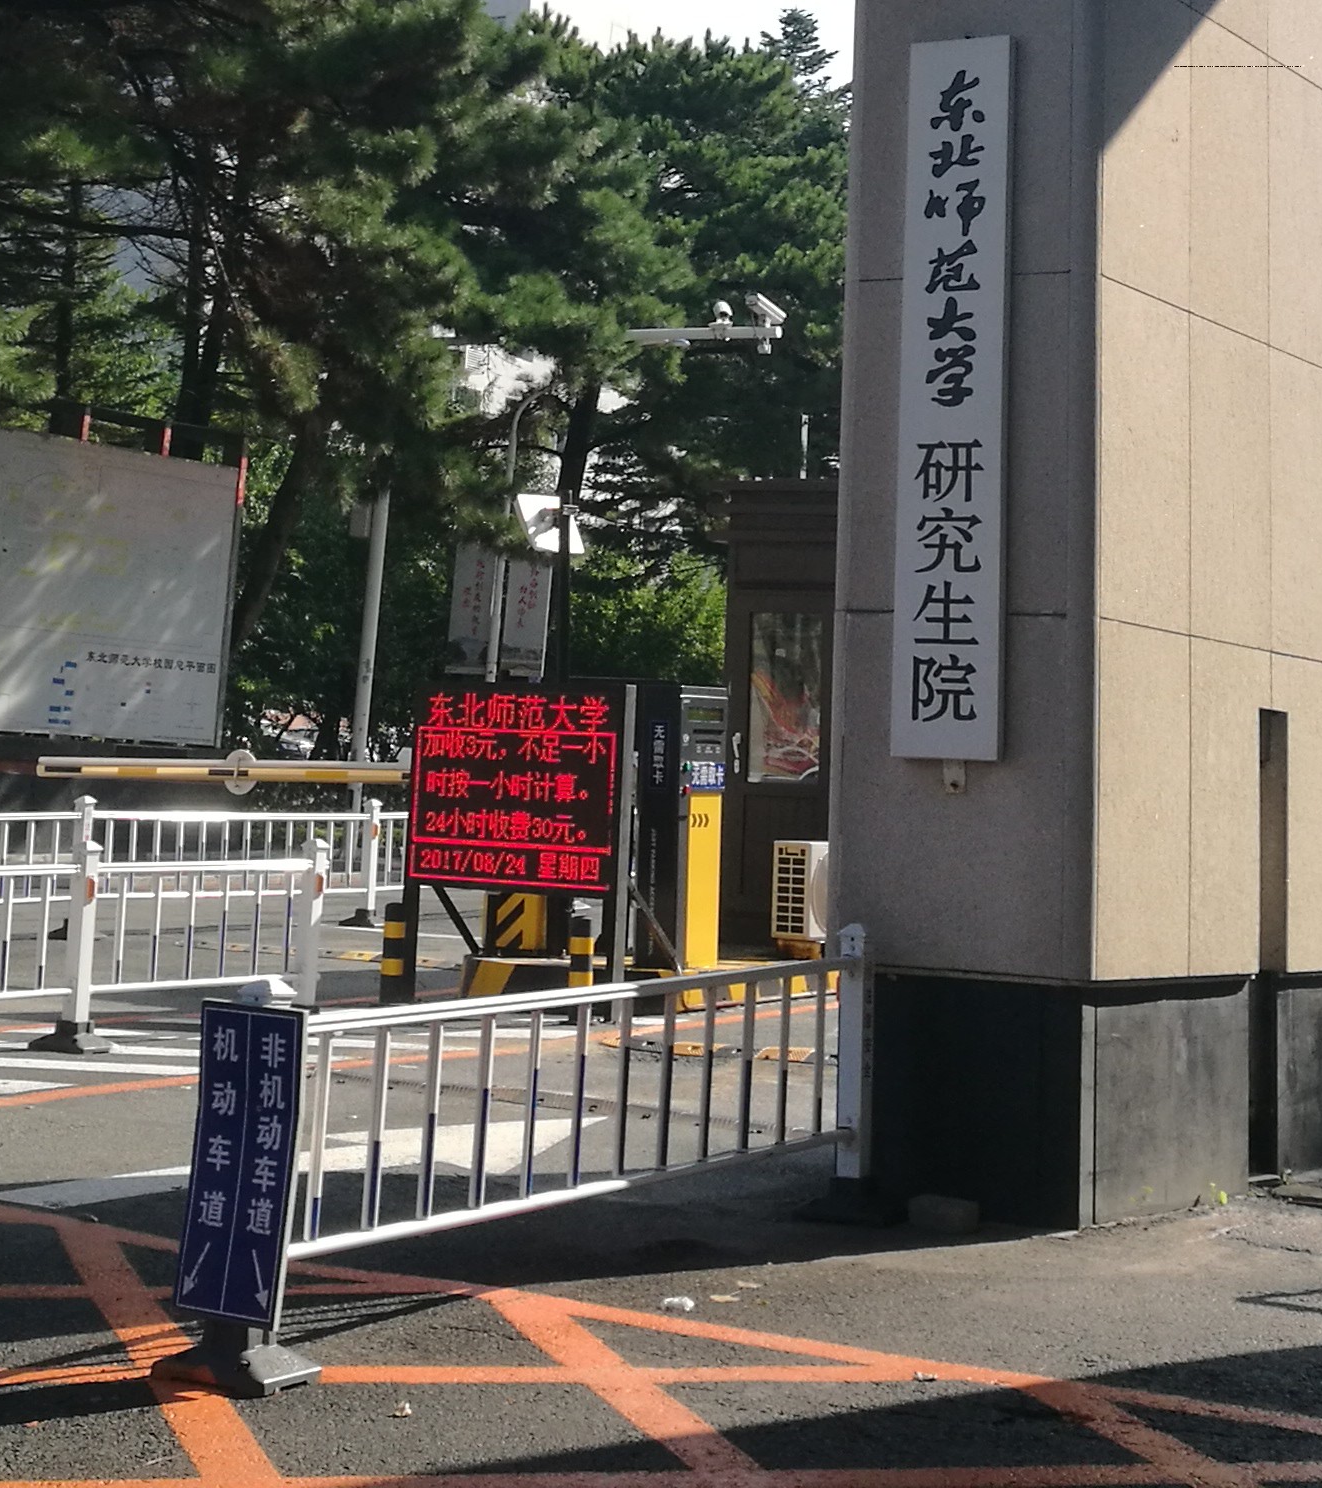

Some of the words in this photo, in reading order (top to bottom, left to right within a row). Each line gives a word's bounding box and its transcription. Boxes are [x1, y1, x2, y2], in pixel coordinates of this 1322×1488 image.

[428, 692, 610, 732] 东北师范大学
[419, 849, 526, 877] 2017/08/24
[537, 852, 601, 881] 星期四
[198, 1025, 239, 1229] 机动车道
[246, 1033, 287, 1236] 非机动车道
